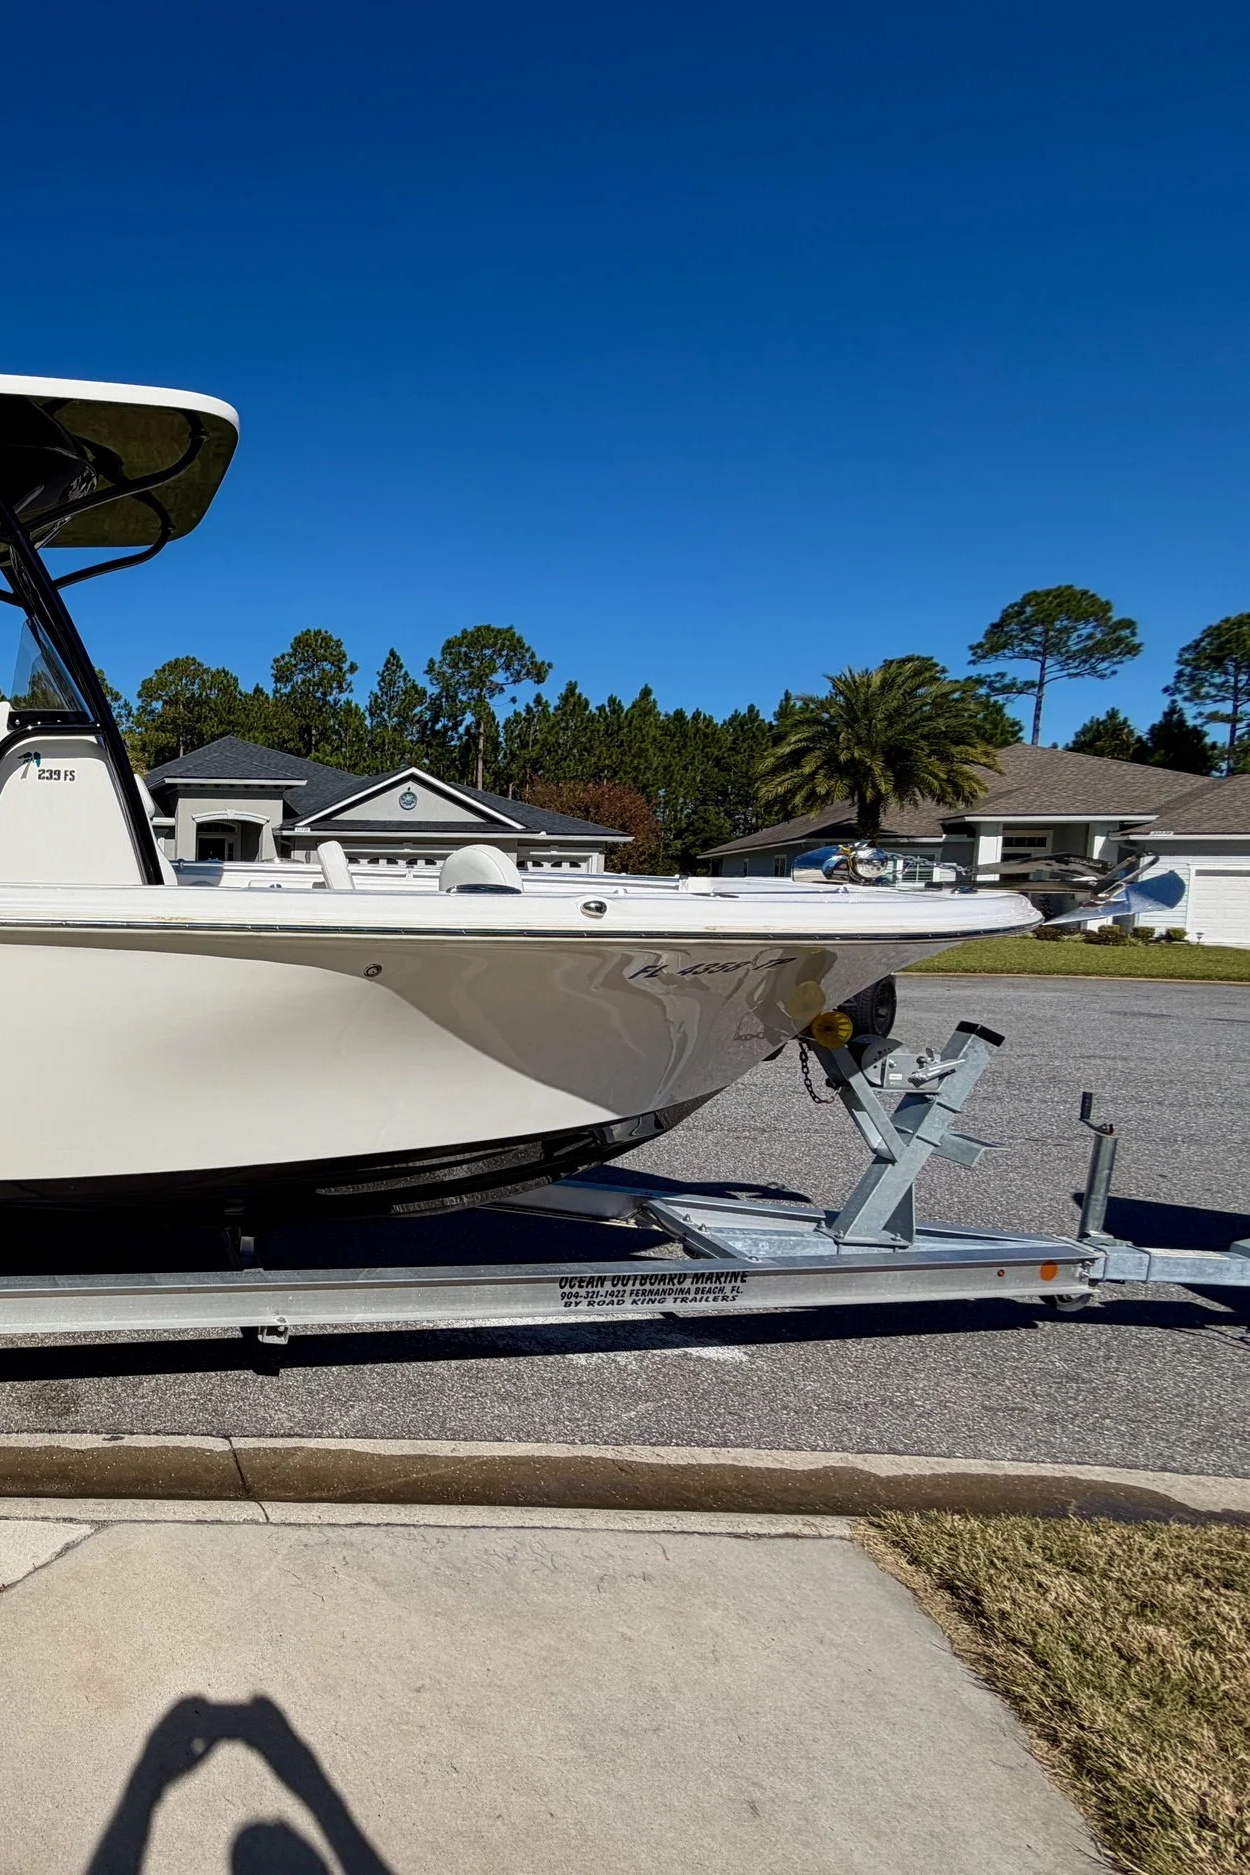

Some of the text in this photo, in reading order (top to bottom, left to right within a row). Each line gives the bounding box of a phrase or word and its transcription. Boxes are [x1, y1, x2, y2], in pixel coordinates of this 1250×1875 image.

[38, 769, 76, 781] 239 FS
[627, 964, 670, 980] FL
[558, 1270, 750, 1290] OCEAN OUTBOARD MARINE
[560, 1285, 744, 1301] 904-321-1422 FERNANDINA BEACH, FL.
[563, 1294, 739, 1308] BY ROAD KING TRAILERS
